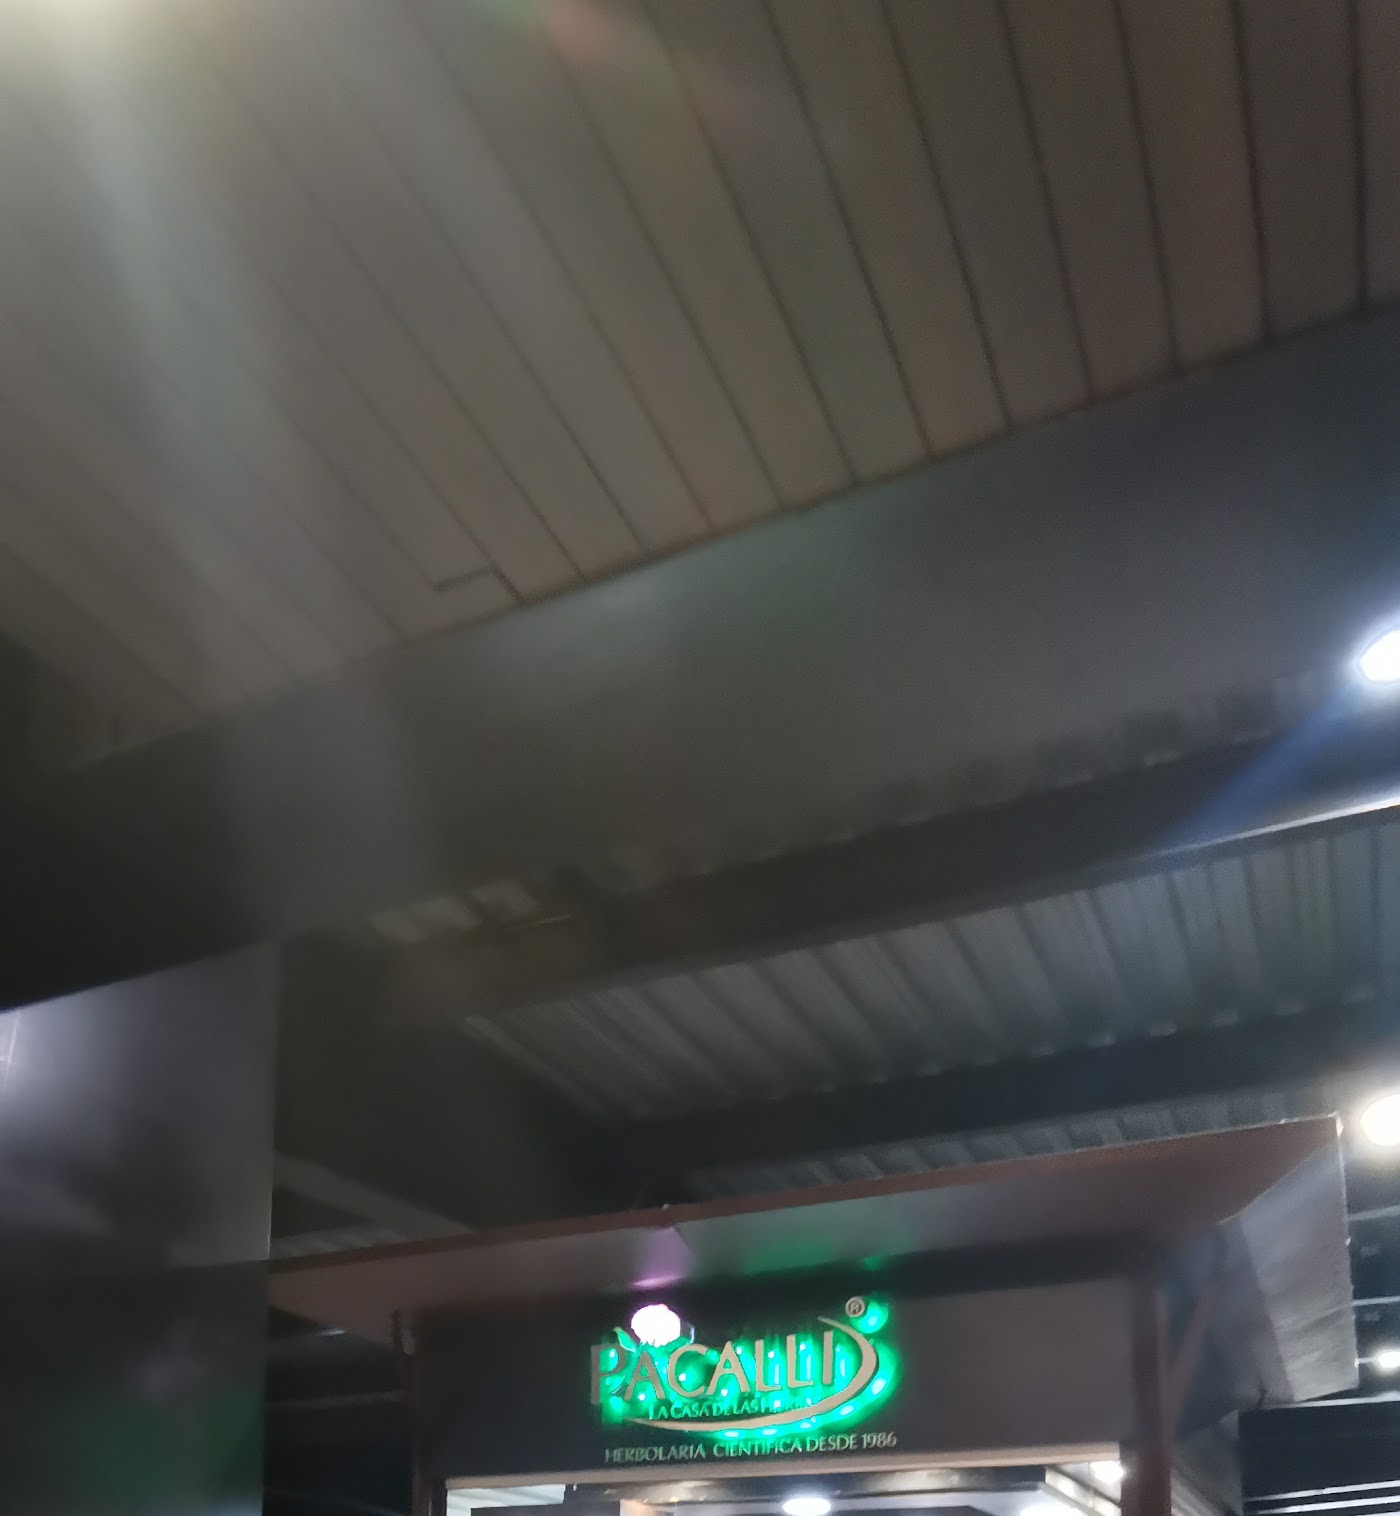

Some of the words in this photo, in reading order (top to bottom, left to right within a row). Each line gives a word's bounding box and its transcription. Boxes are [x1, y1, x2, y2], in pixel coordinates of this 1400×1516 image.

[590, 1330, 834, 1405] PACALLI
[648, 1404, 669, 1420] LA
[670, 1402, 710, 1419] CASA
[733, 1398, 759, 1415] LAS
[604, 1443, 706, 1463] HERBOLARIA
[806, 1433, 858, 1452] DESDE
[861, 1431, 898, 1449] 1986
